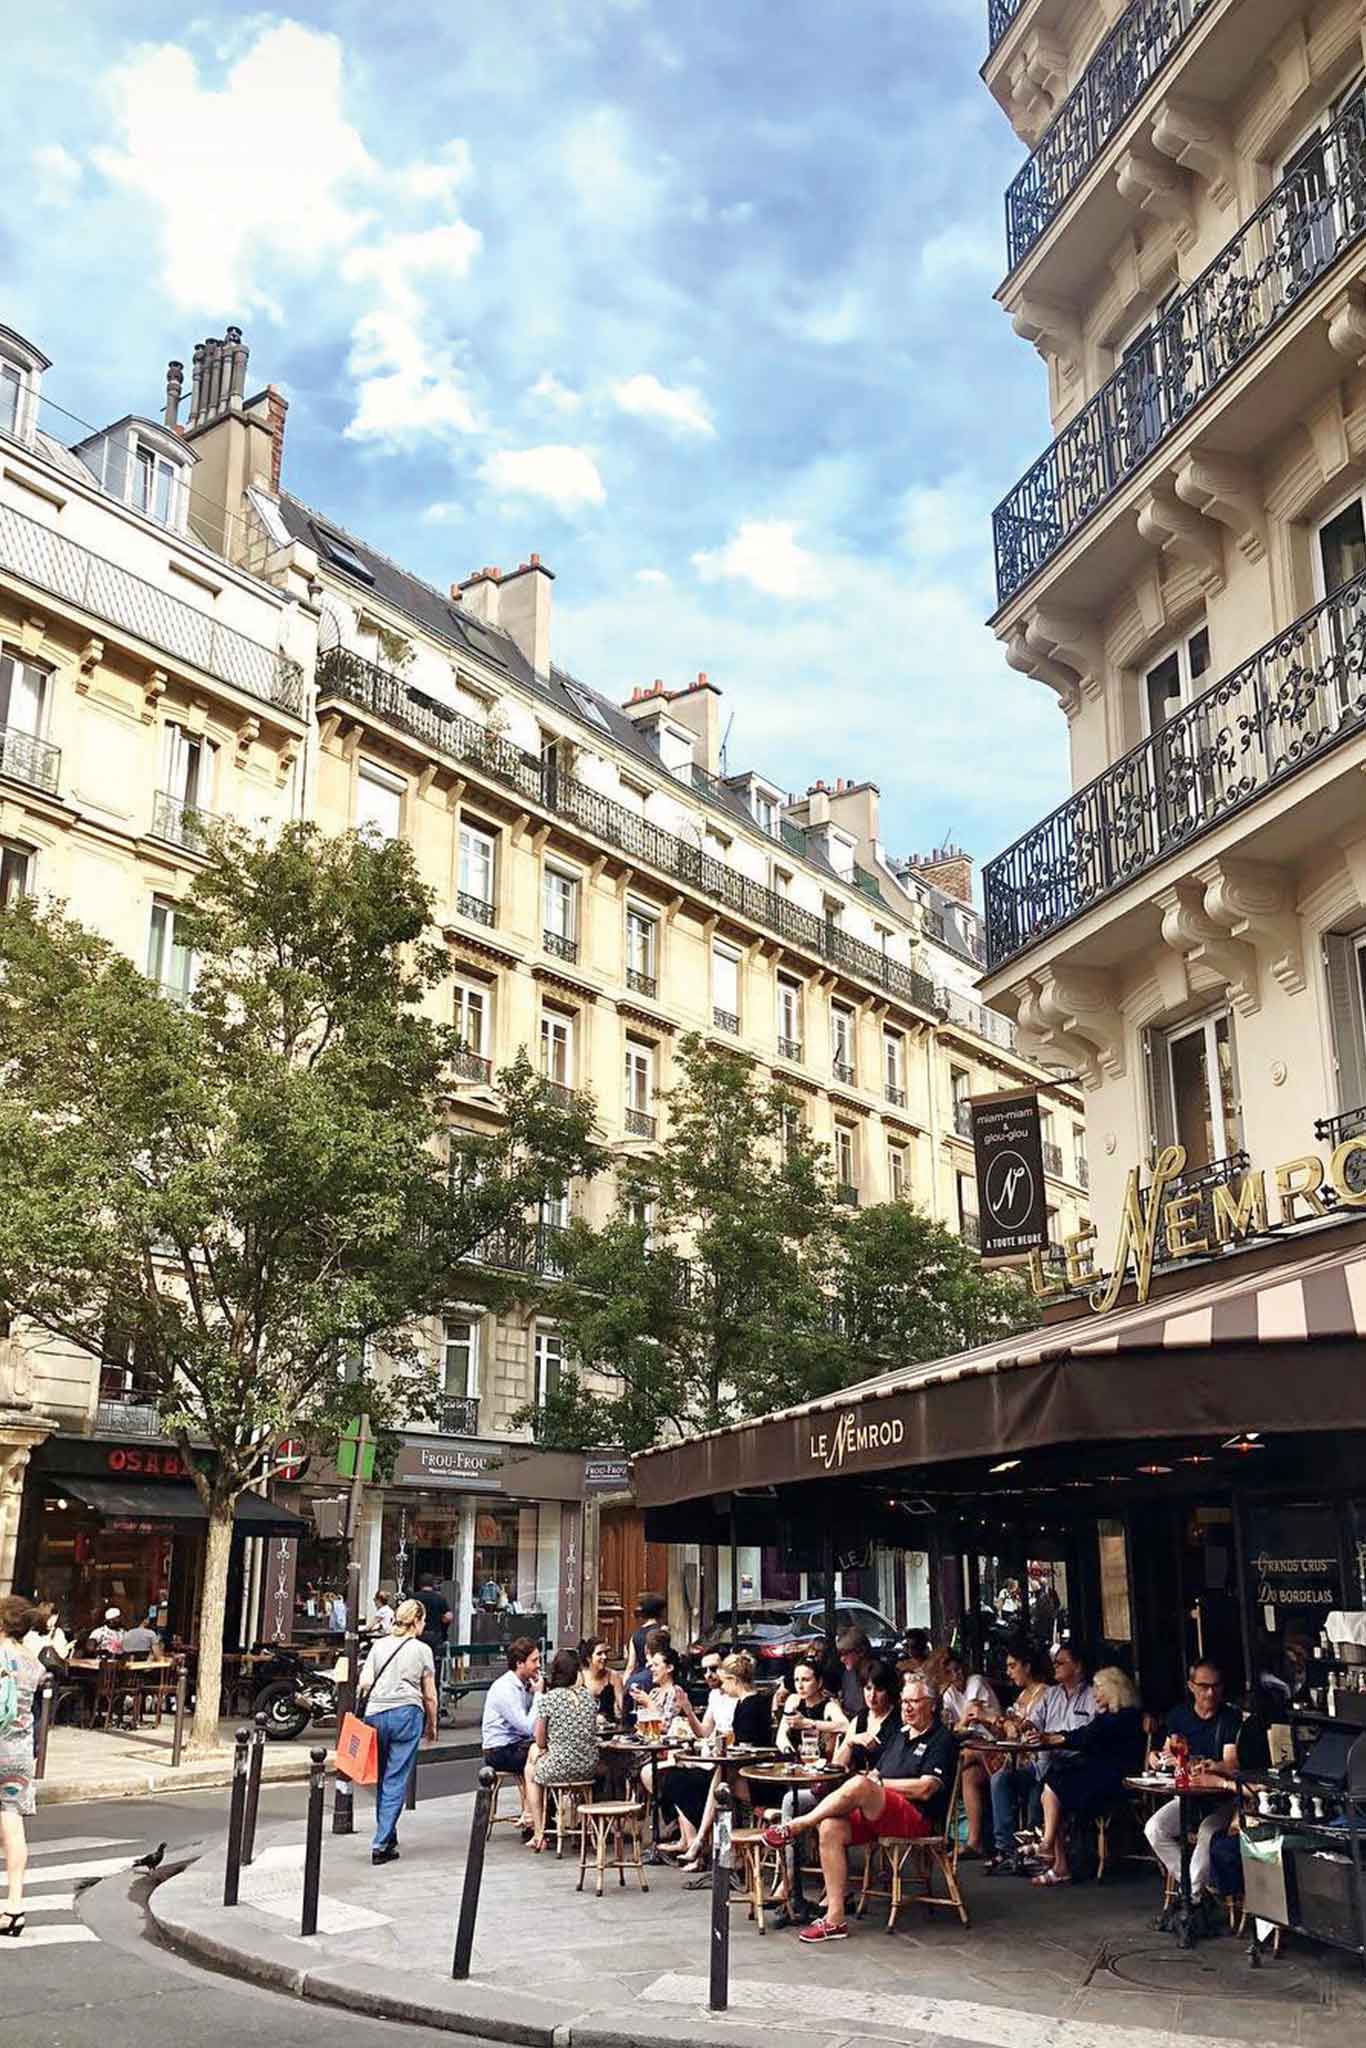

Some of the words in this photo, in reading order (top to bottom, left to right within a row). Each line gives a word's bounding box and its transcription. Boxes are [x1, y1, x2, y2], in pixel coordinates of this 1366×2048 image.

[976, 1108, 1033, 1125] miam-miam
[983, 1128, 1029, 1146] glou-glou
[992, 1236, 1017, 1249] TOUTE
[1017, 1232, 1043, 1246] HEURE
[1028, 1224, 1102, 1298] LE
[810, 1434, 828, 1458] LE
[824, 1412, 904, 1469] NEMROD
[1279, 1589, 1334, 1604] BORDELAIS
